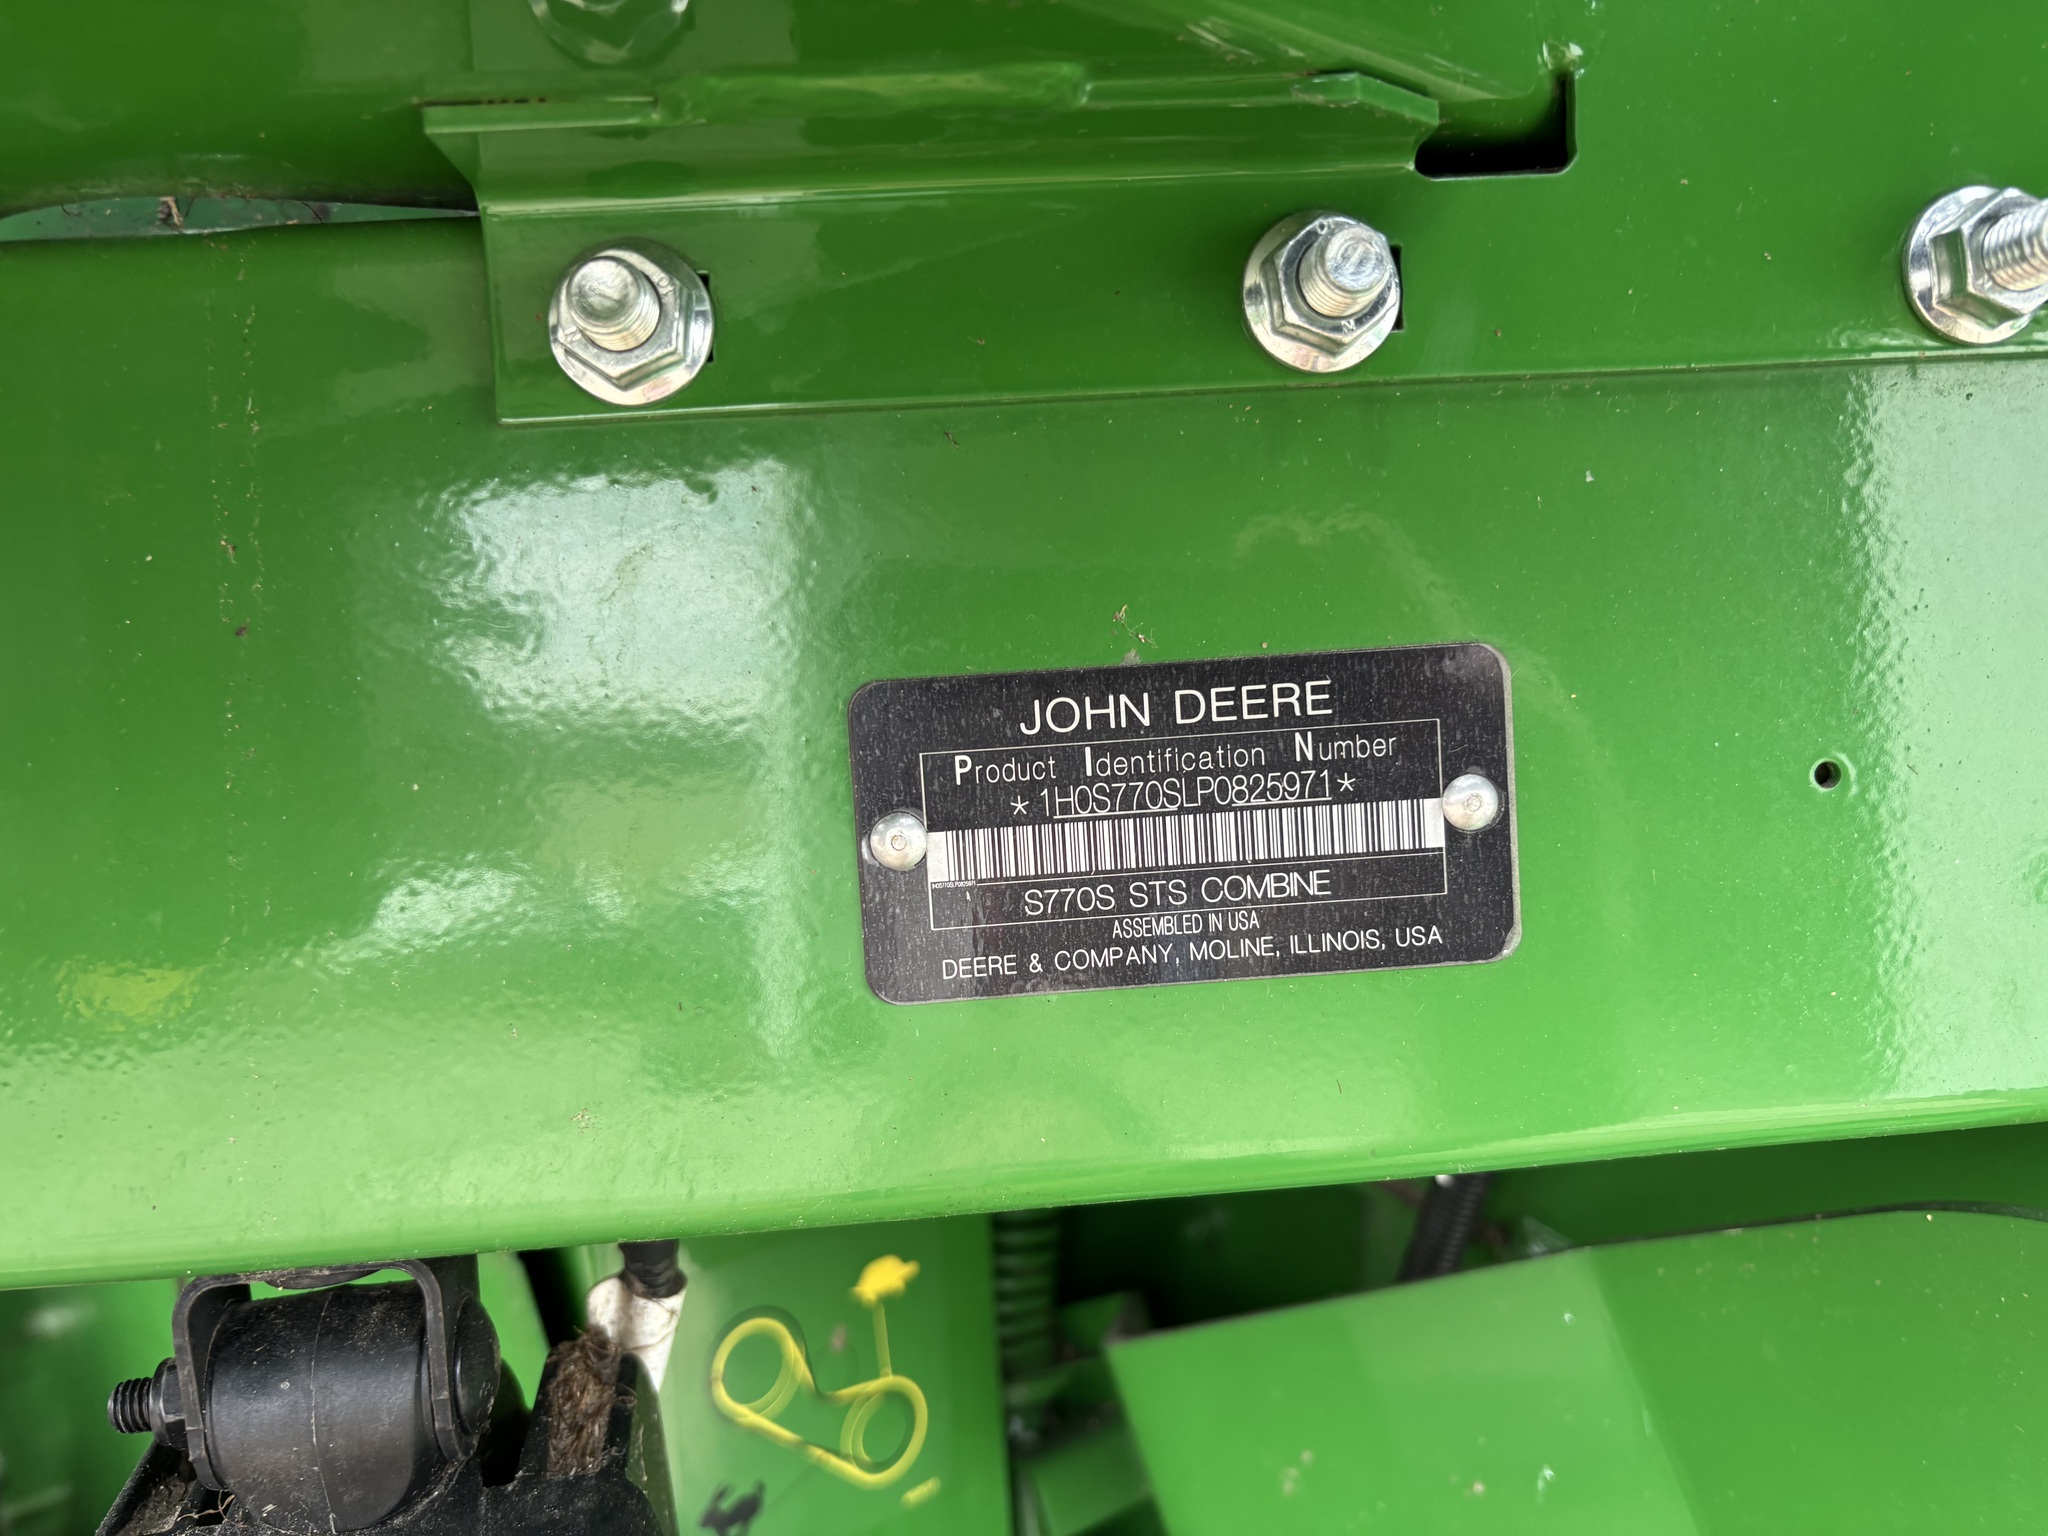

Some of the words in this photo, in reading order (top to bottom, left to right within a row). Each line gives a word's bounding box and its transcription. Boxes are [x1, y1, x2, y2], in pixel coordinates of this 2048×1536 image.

[1019, 692, 1151, 735] JOHN
[1174, 679, 1333, 725] DEERE
[954, 754, 1057, 786] Product
[1084, 743, 1265, 777] Identification
[1294, 731, 1397, 762] Number
[1024, 884, 1116, 916] S770S
[1129, 878, 1188, 908] STS
[1201, 869, 1332, 903] COMBINE
[1112, 914, 1203, 939] ASSEMBLED
[1208, 912, 1223, 932] IN
[1228, 910, 1260, 931] USA
[942, 954, 1018, 980] DEERE
[1028, 953, 1044, 973] &
[1054, 943, 1181, 972] COMPANY,
[1189, 936, 1281, 962] MOLINE,
[1289, 929, 1386, 955] ILLINOIS,
[1395, 925, 1443, 948] USA
